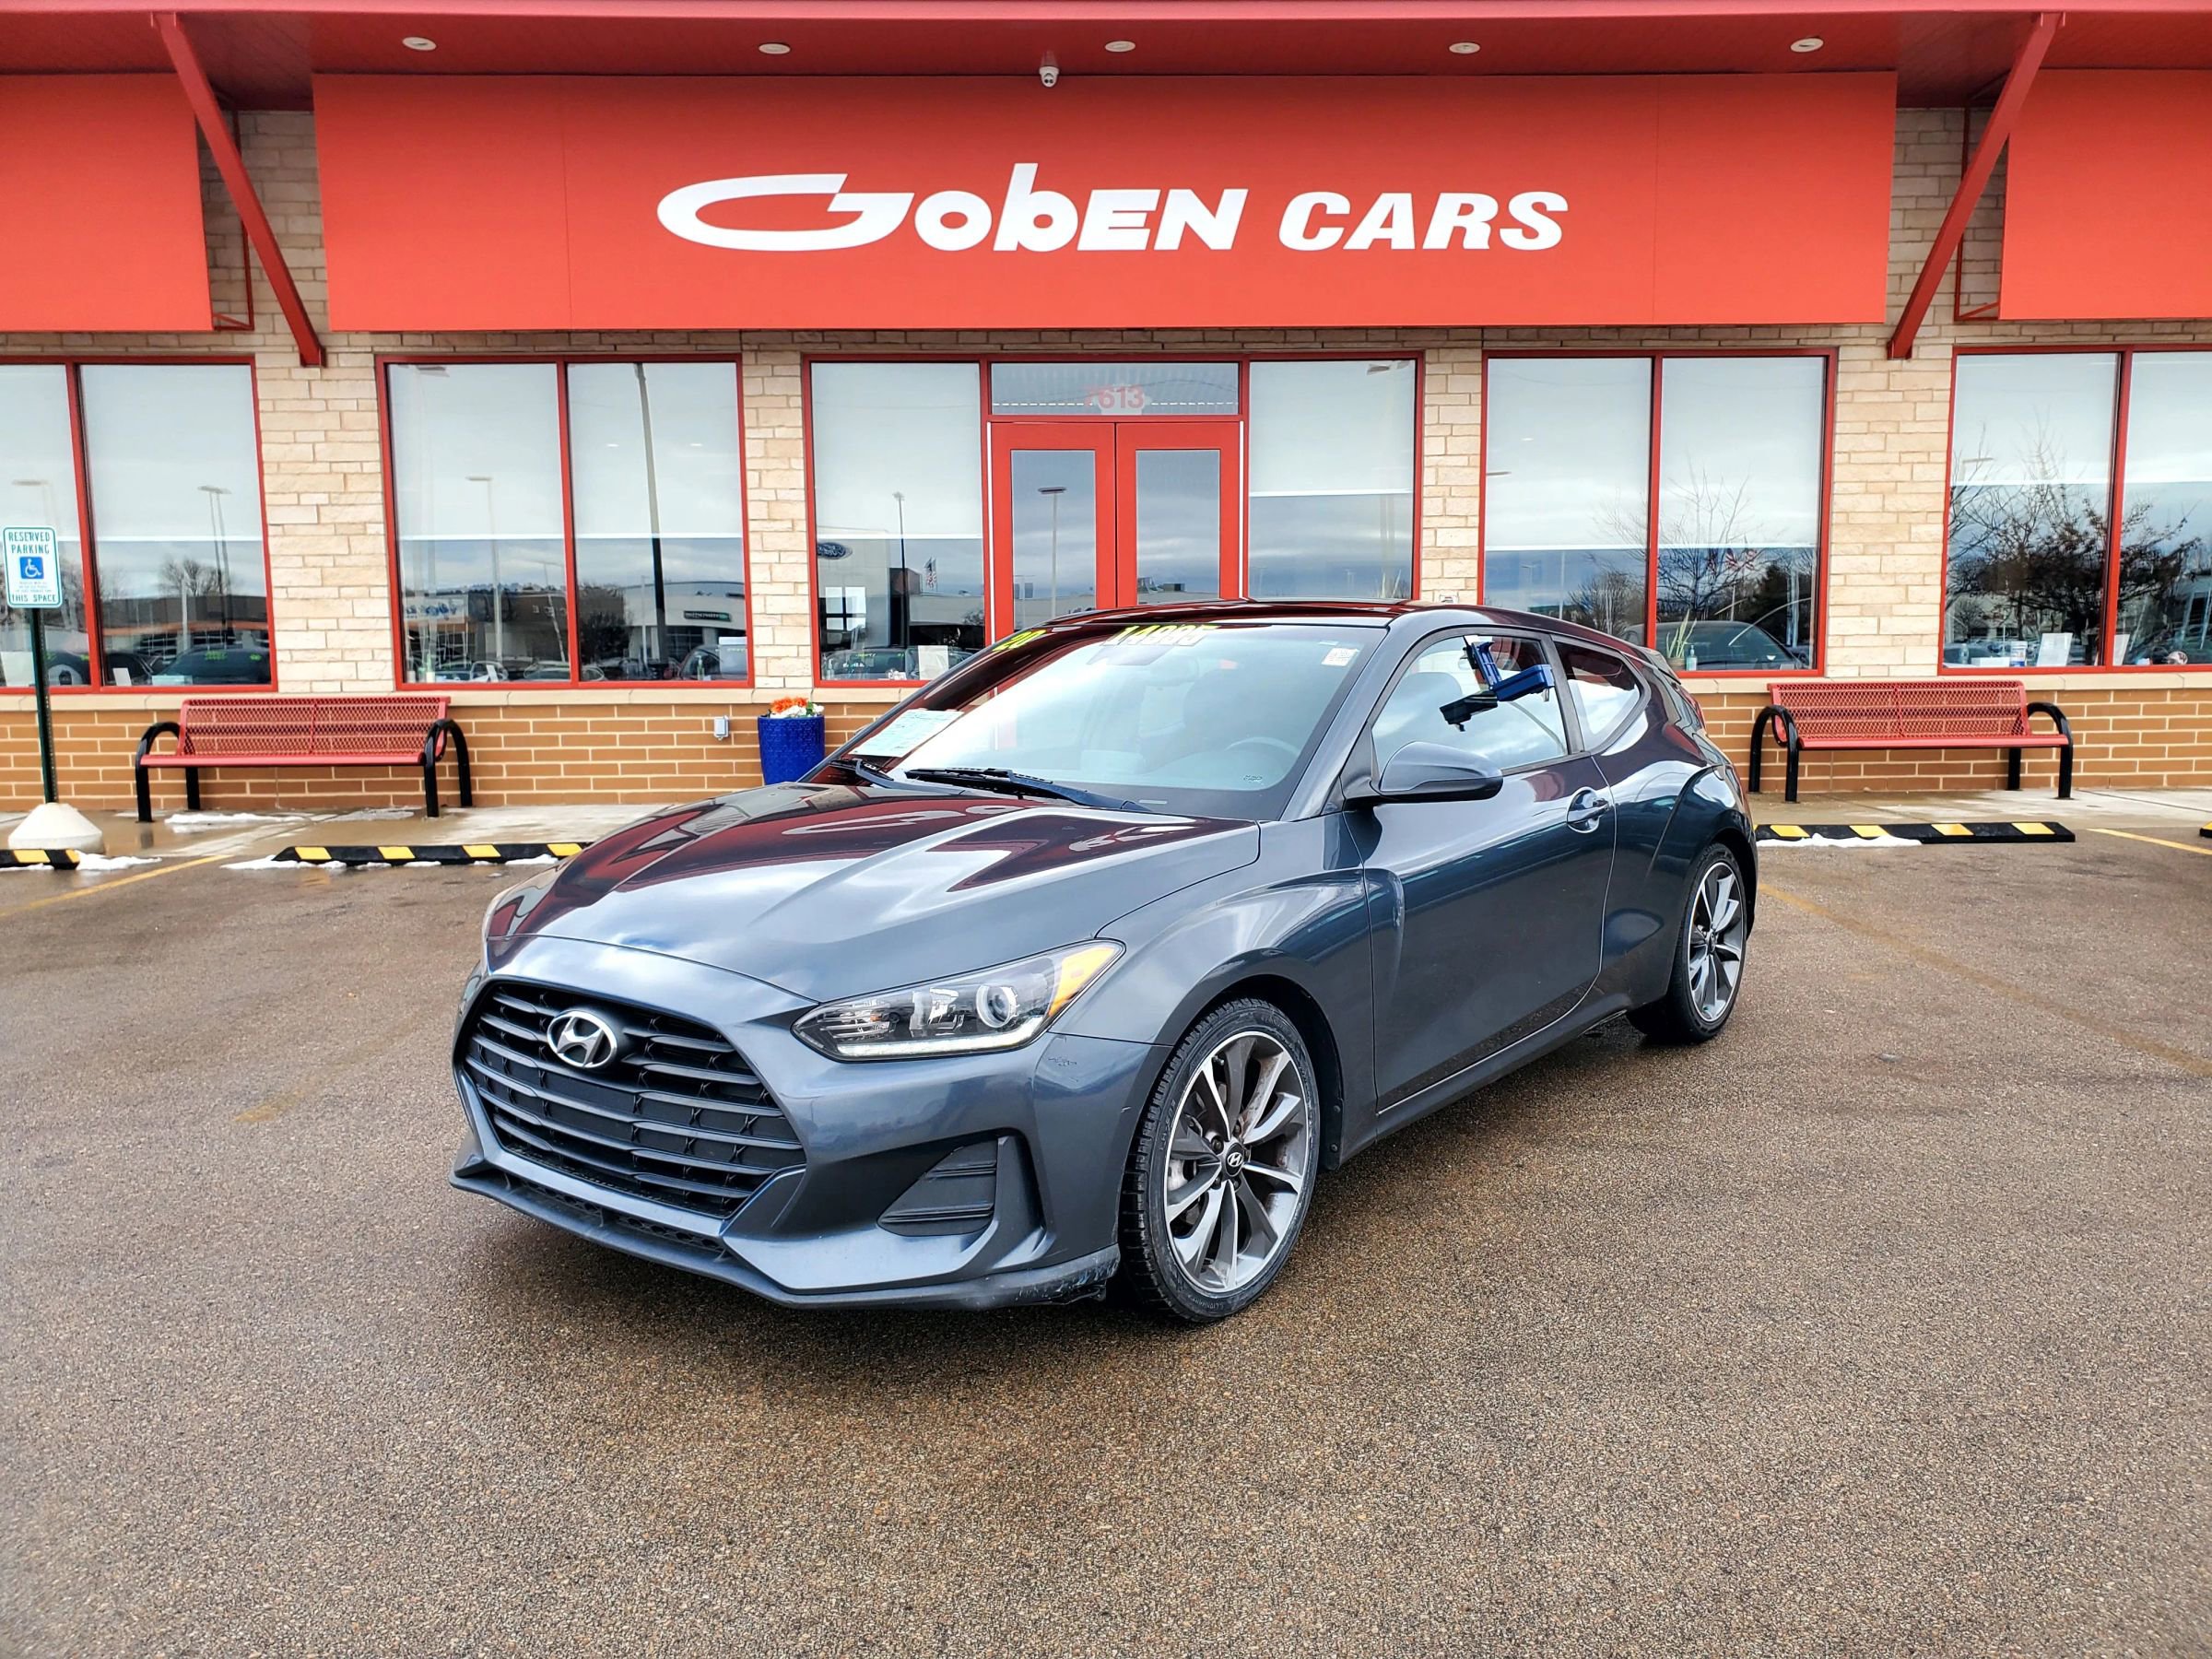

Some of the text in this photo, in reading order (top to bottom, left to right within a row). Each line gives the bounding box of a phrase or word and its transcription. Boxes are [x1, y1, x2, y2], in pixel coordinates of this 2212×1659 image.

[1279, 191, 1568, 252] CARS
[1099, 386, 1145, 409] 613
[8, 531, 51, 542] RESERVED
[11, 544, 50, 554] PARKING
[11, 594, 56, 603] THIS SPACE
